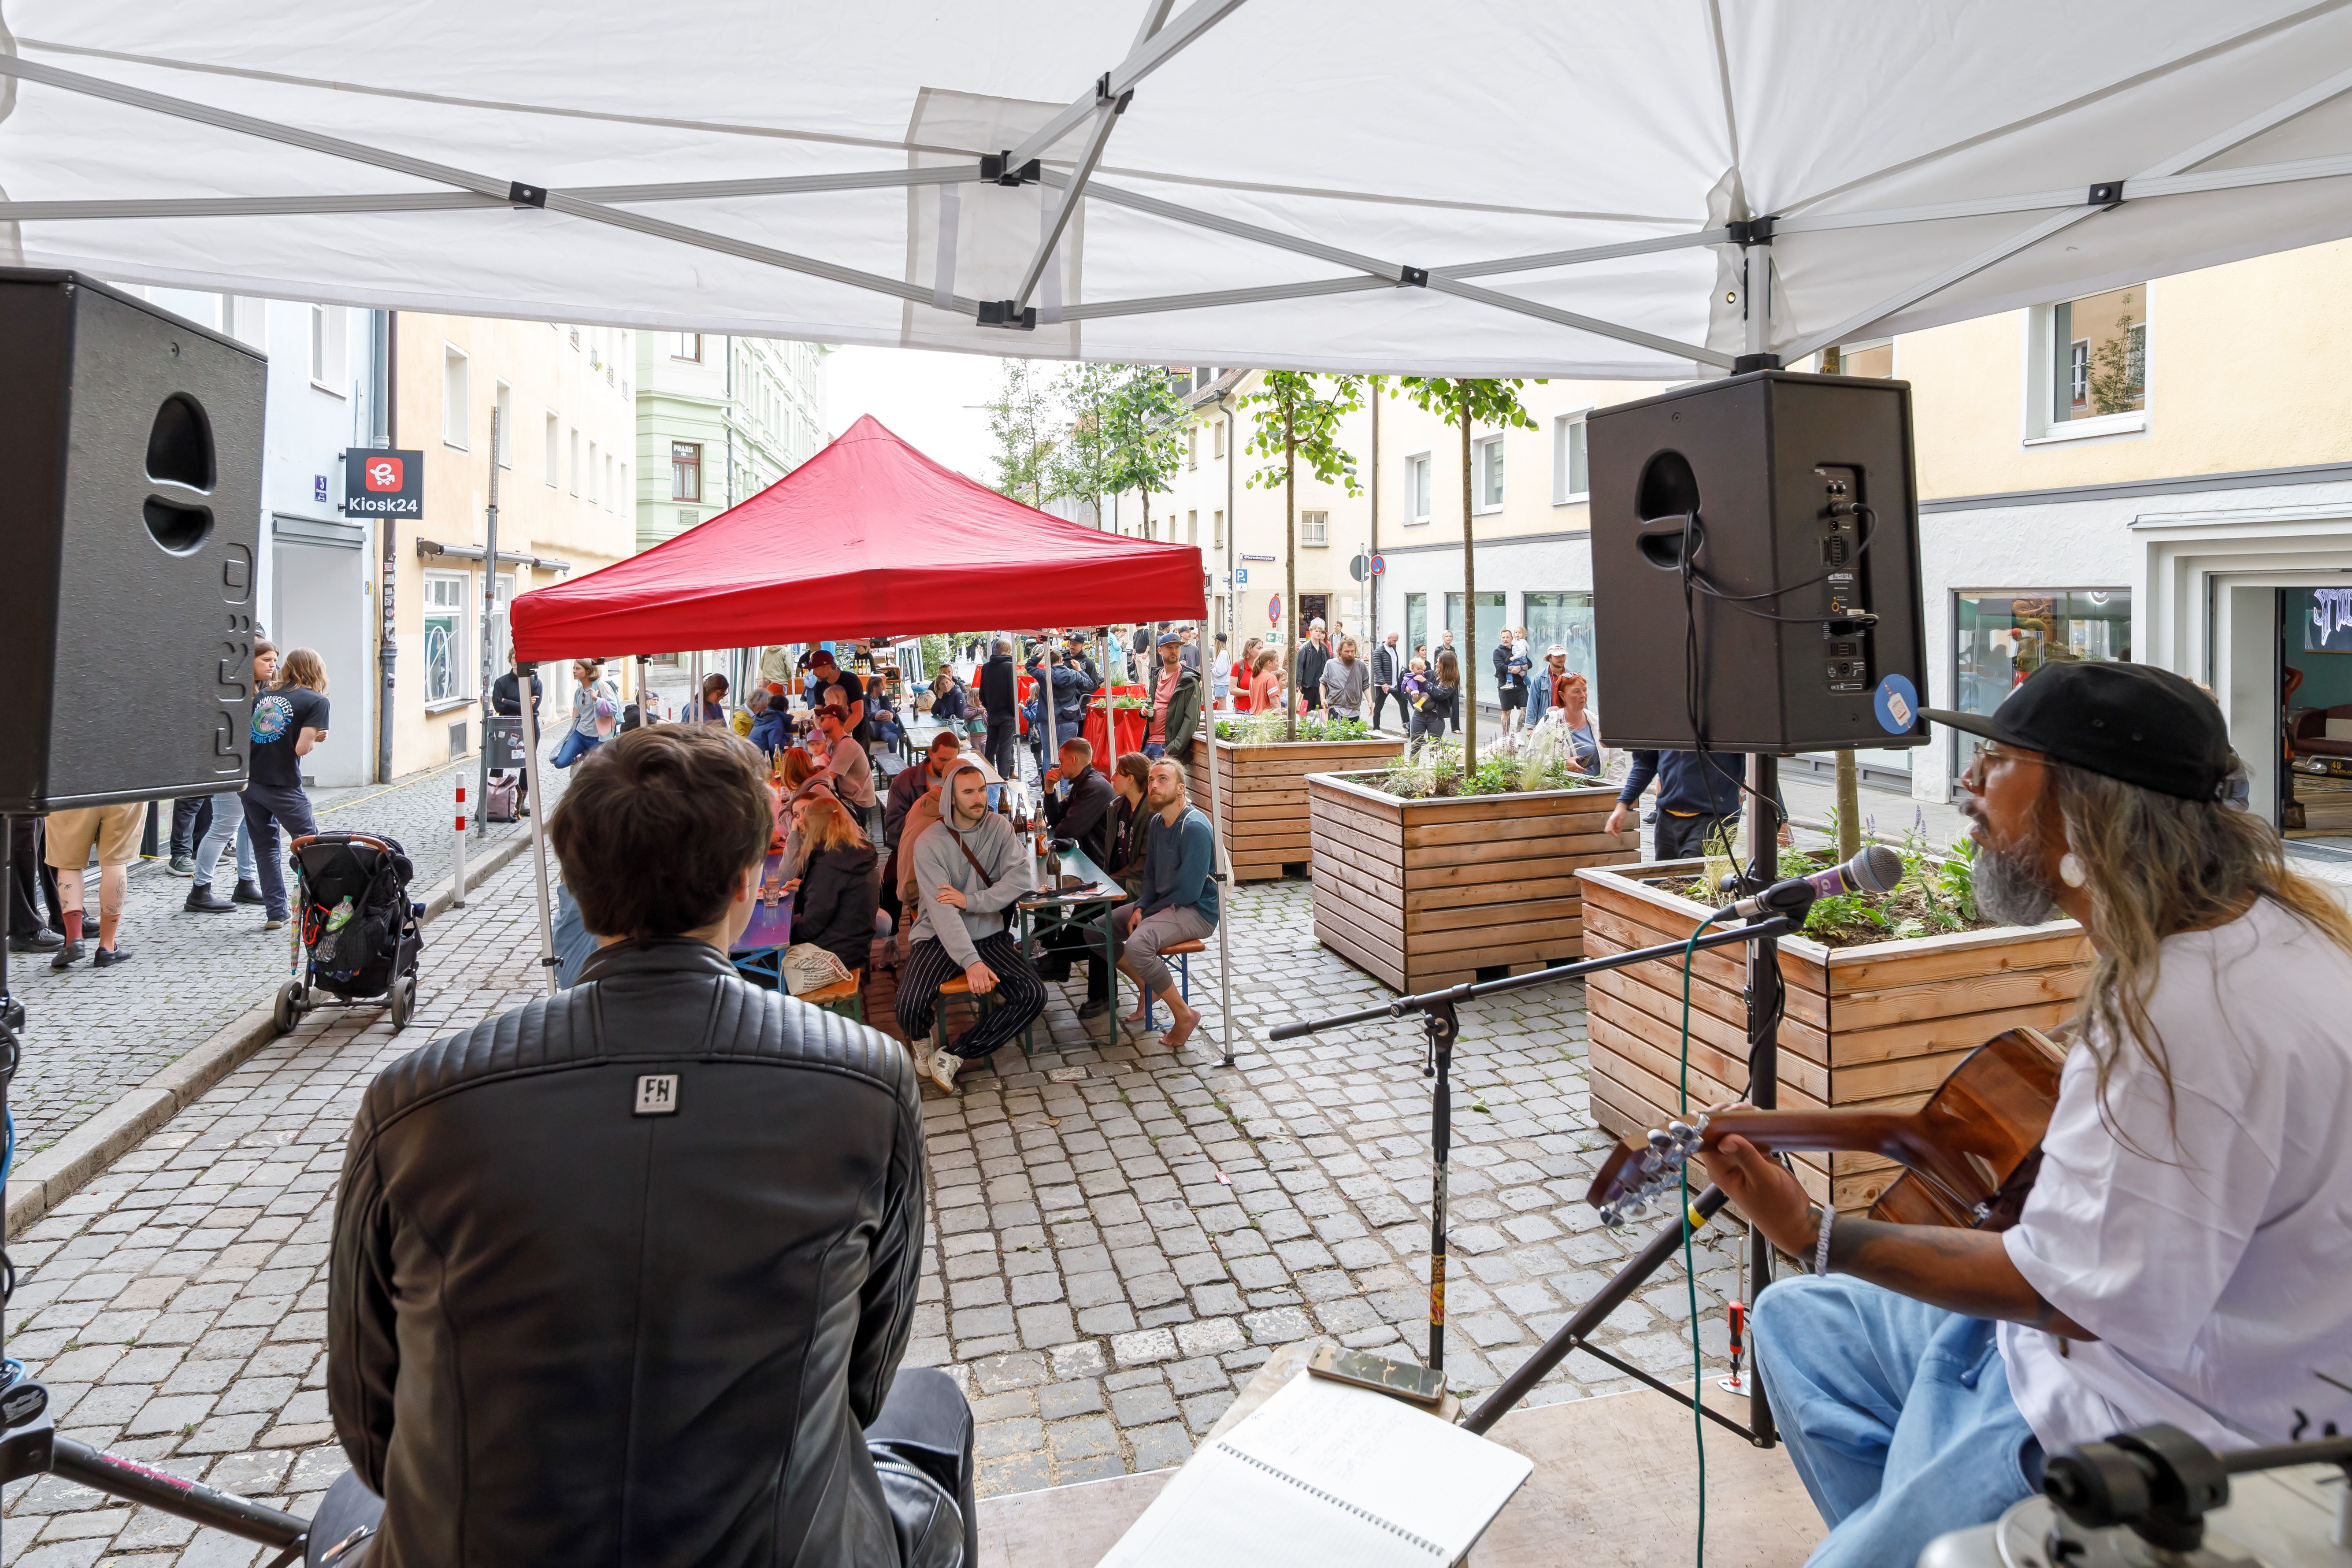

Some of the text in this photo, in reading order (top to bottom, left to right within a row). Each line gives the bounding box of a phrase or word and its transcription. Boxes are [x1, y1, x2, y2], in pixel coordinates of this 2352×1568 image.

[320, 477, 324, 489] 5
[349, 497, 418, 512] Kiosk24
[1237, 570, 1245, 582] P
